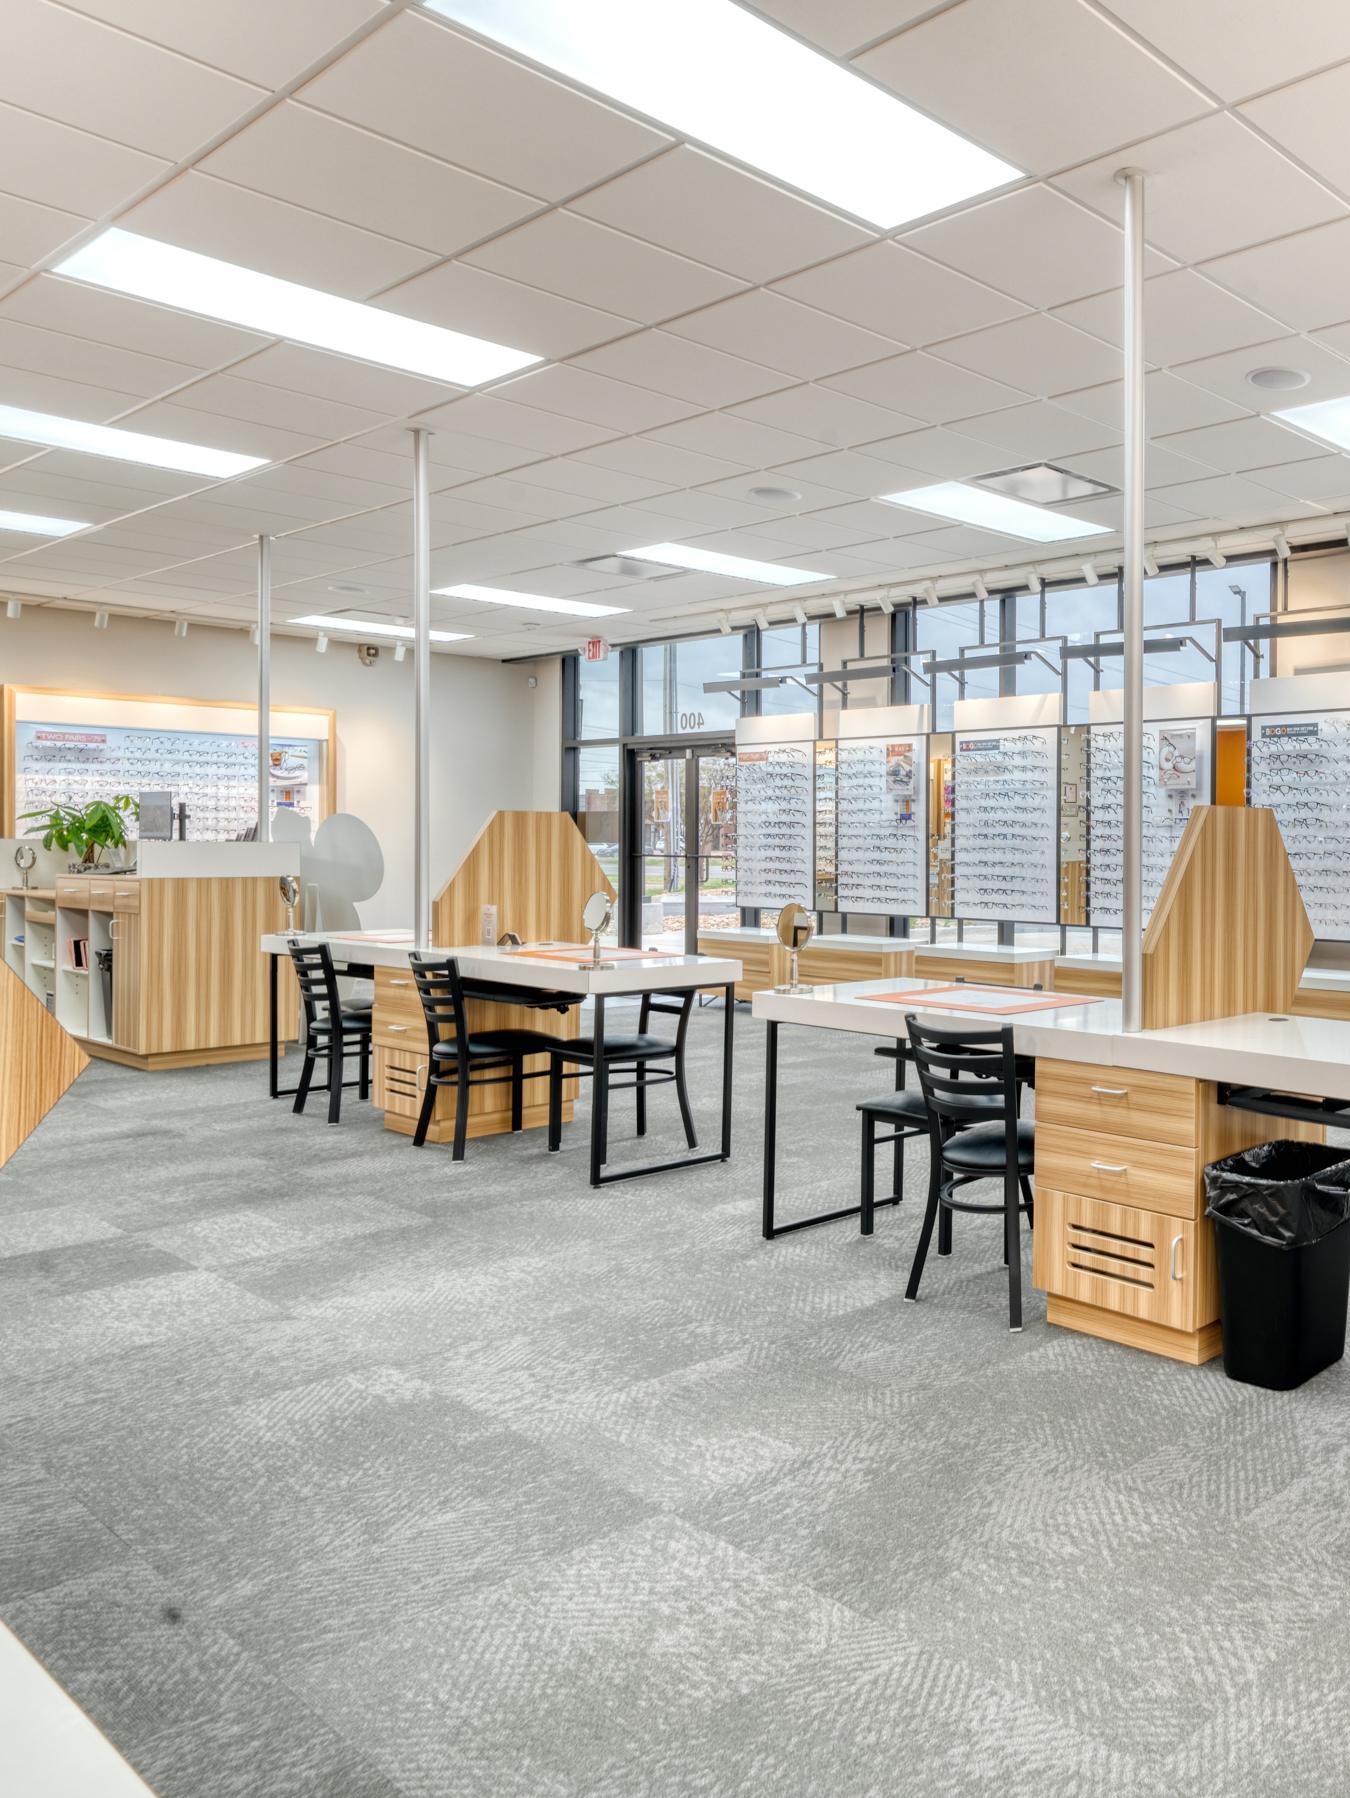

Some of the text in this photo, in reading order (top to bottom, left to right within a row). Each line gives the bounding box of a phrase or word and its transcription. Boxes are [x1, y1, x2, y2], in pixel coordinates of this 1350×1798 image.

[588, 640, 601, 660] EXIT
[1266, 727, 1286, 735] BOGO
[65, 734, 87, 742] PAIRS
